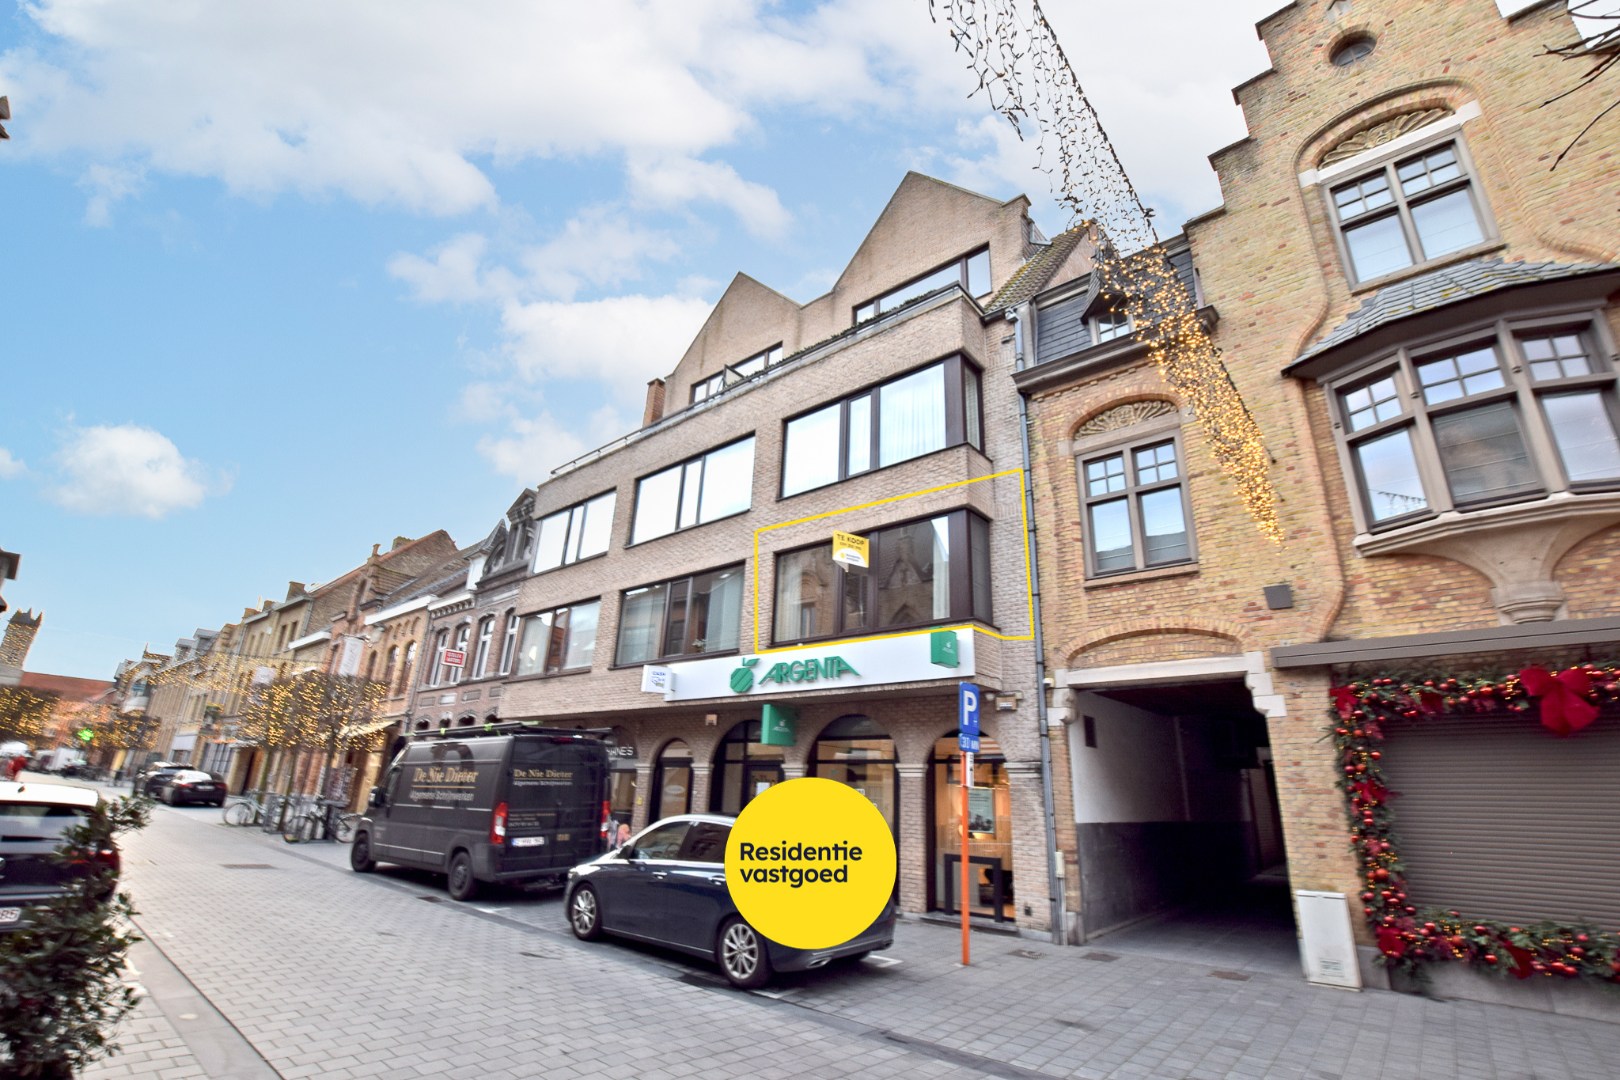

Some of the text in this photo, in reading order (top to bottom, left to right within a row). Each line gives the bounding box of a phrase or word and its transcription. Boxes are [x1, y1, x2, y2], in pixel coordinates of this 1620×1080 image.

[758, 656, 862, 685] ARGENTA
[963, 690, 978, 726] P
[413, 765, 479, 783] De Nie Dieter
[513, 768, 574, 778] De Nie Dieter
